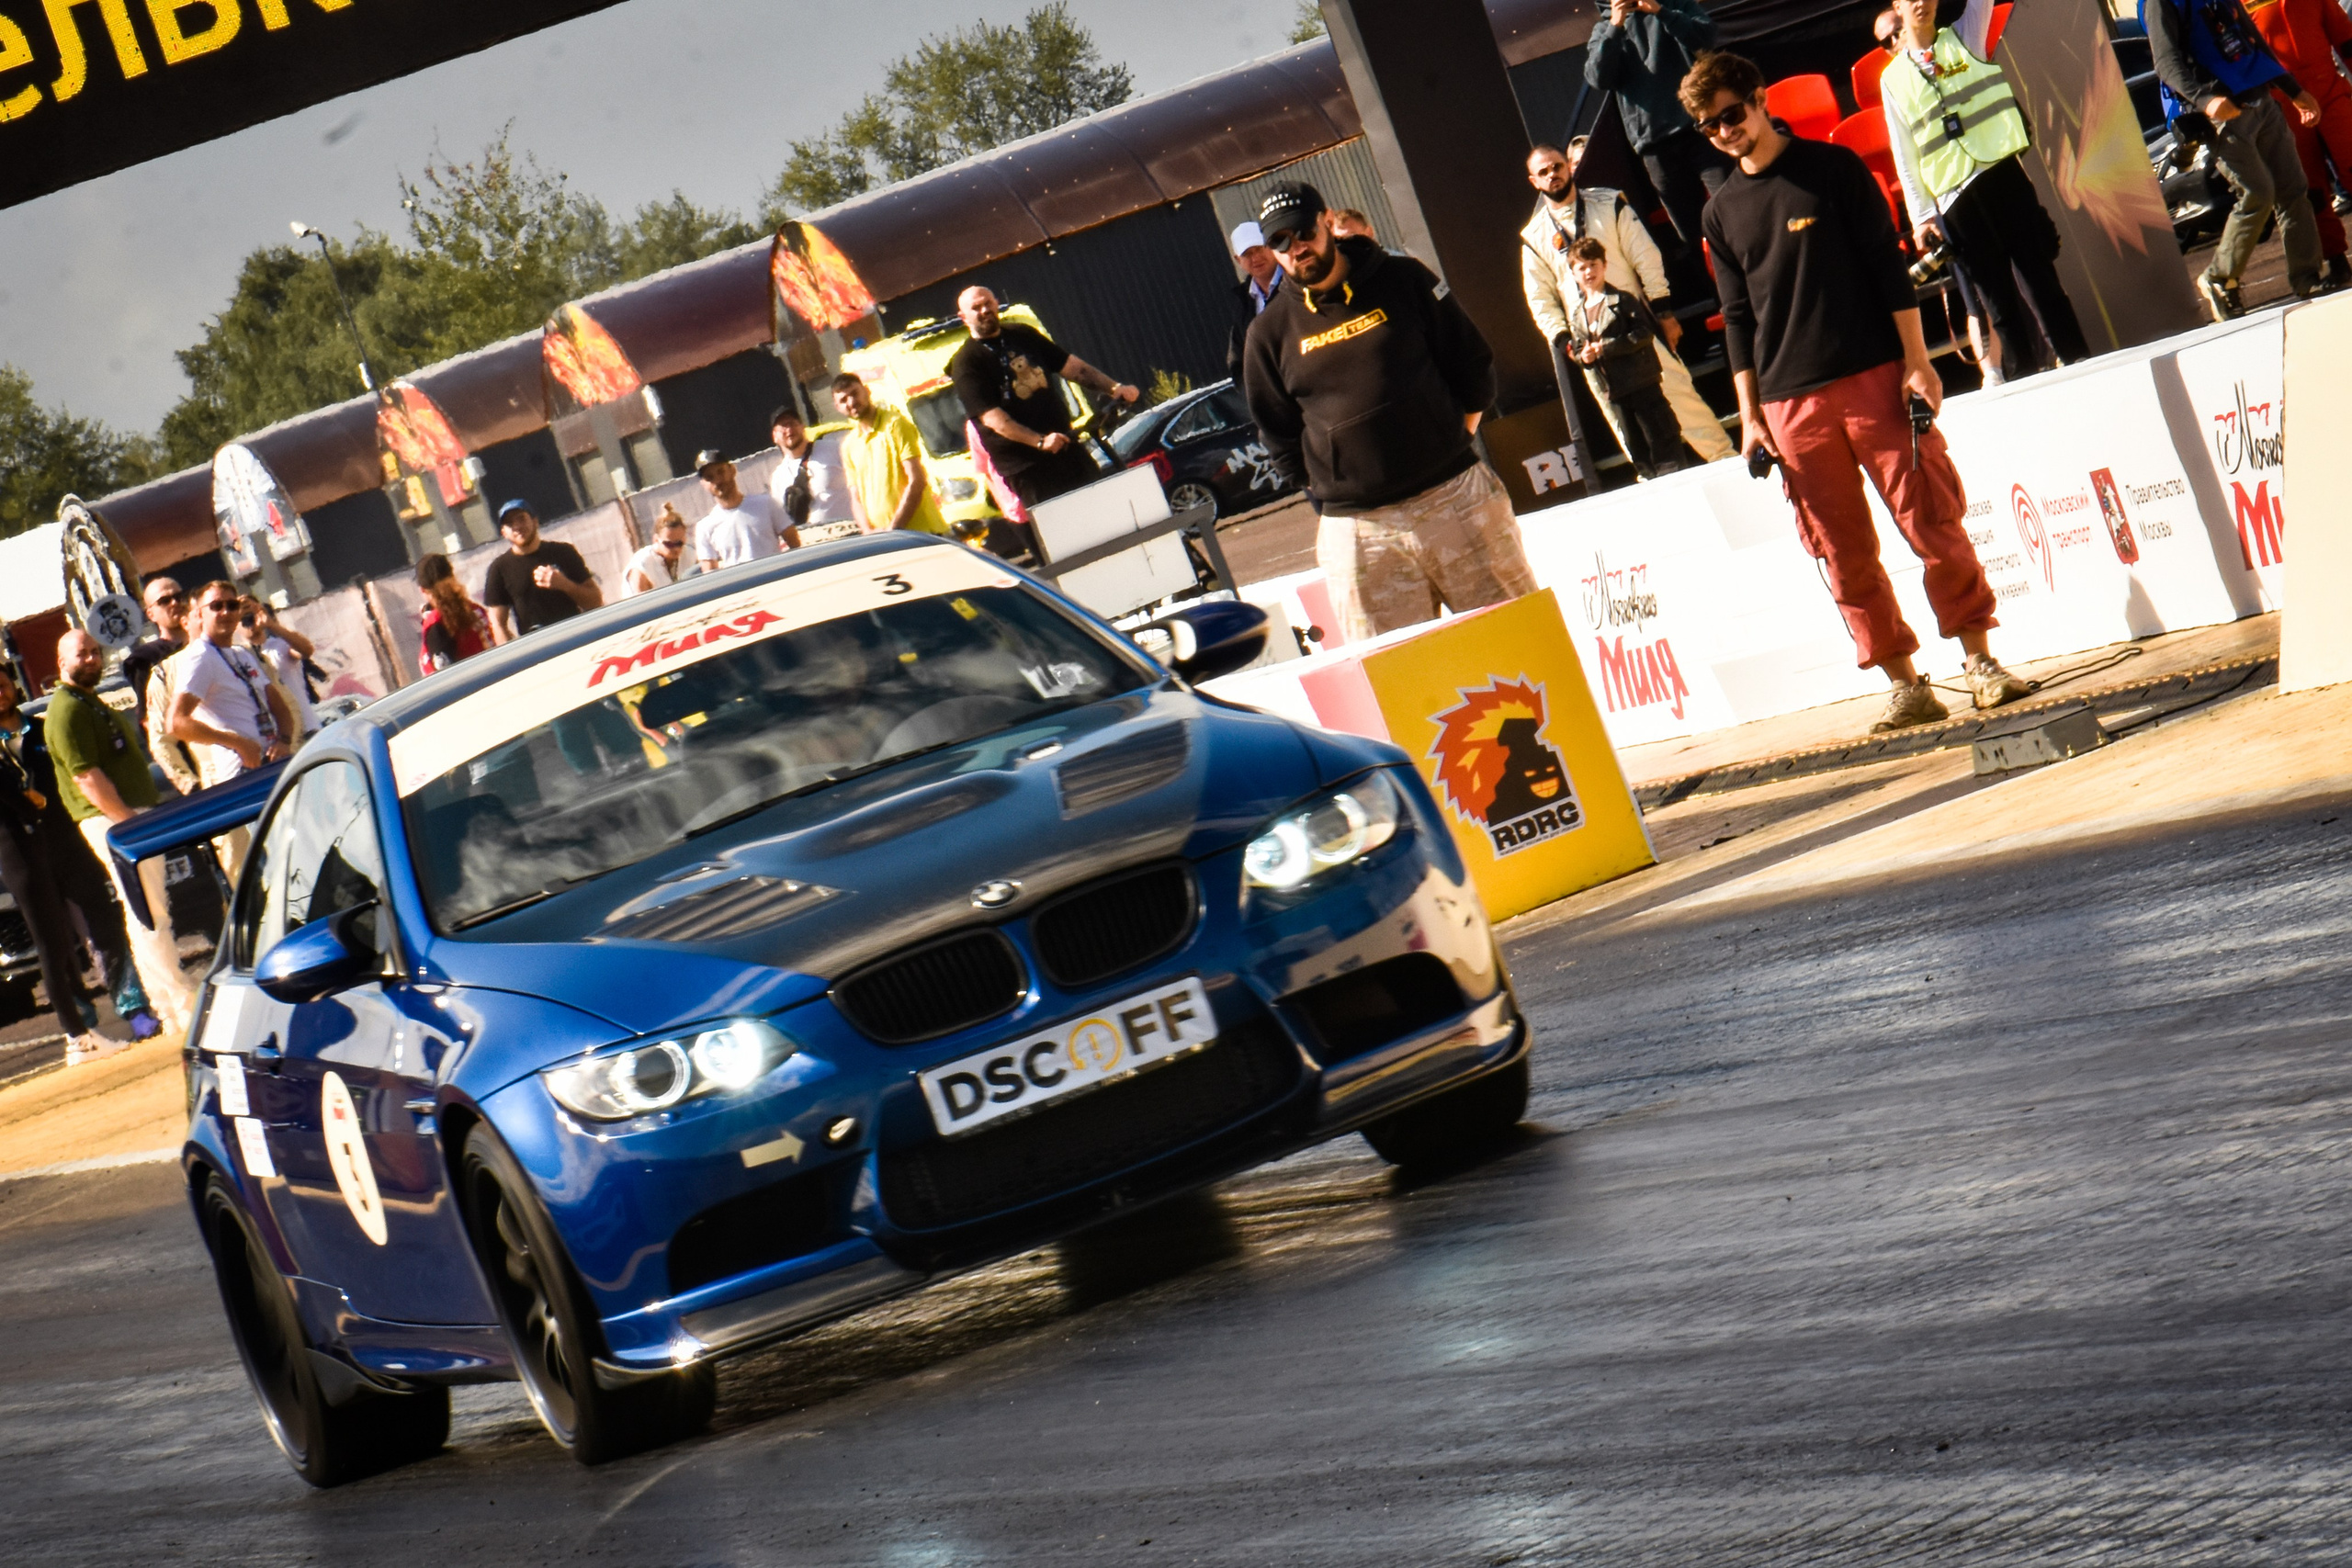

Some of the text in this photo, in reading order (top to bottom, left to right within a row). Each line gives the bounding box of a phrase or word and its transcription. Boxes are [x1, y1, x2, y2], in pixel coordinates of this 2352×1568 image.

[1301, 313, 1380, 355] FAKE TEAM
[2041, 488, 2090, 517] Московский
[2125, 479, 2186, 510] Правительство
[2052, 525, 2091, 552] транспорт
[2138, 520, 2173, 542] Москвы
[872, 573, 912, 596] 3
[587, 610, 786, 688] Миля
[1595, 636, 1690, 720] Миля
